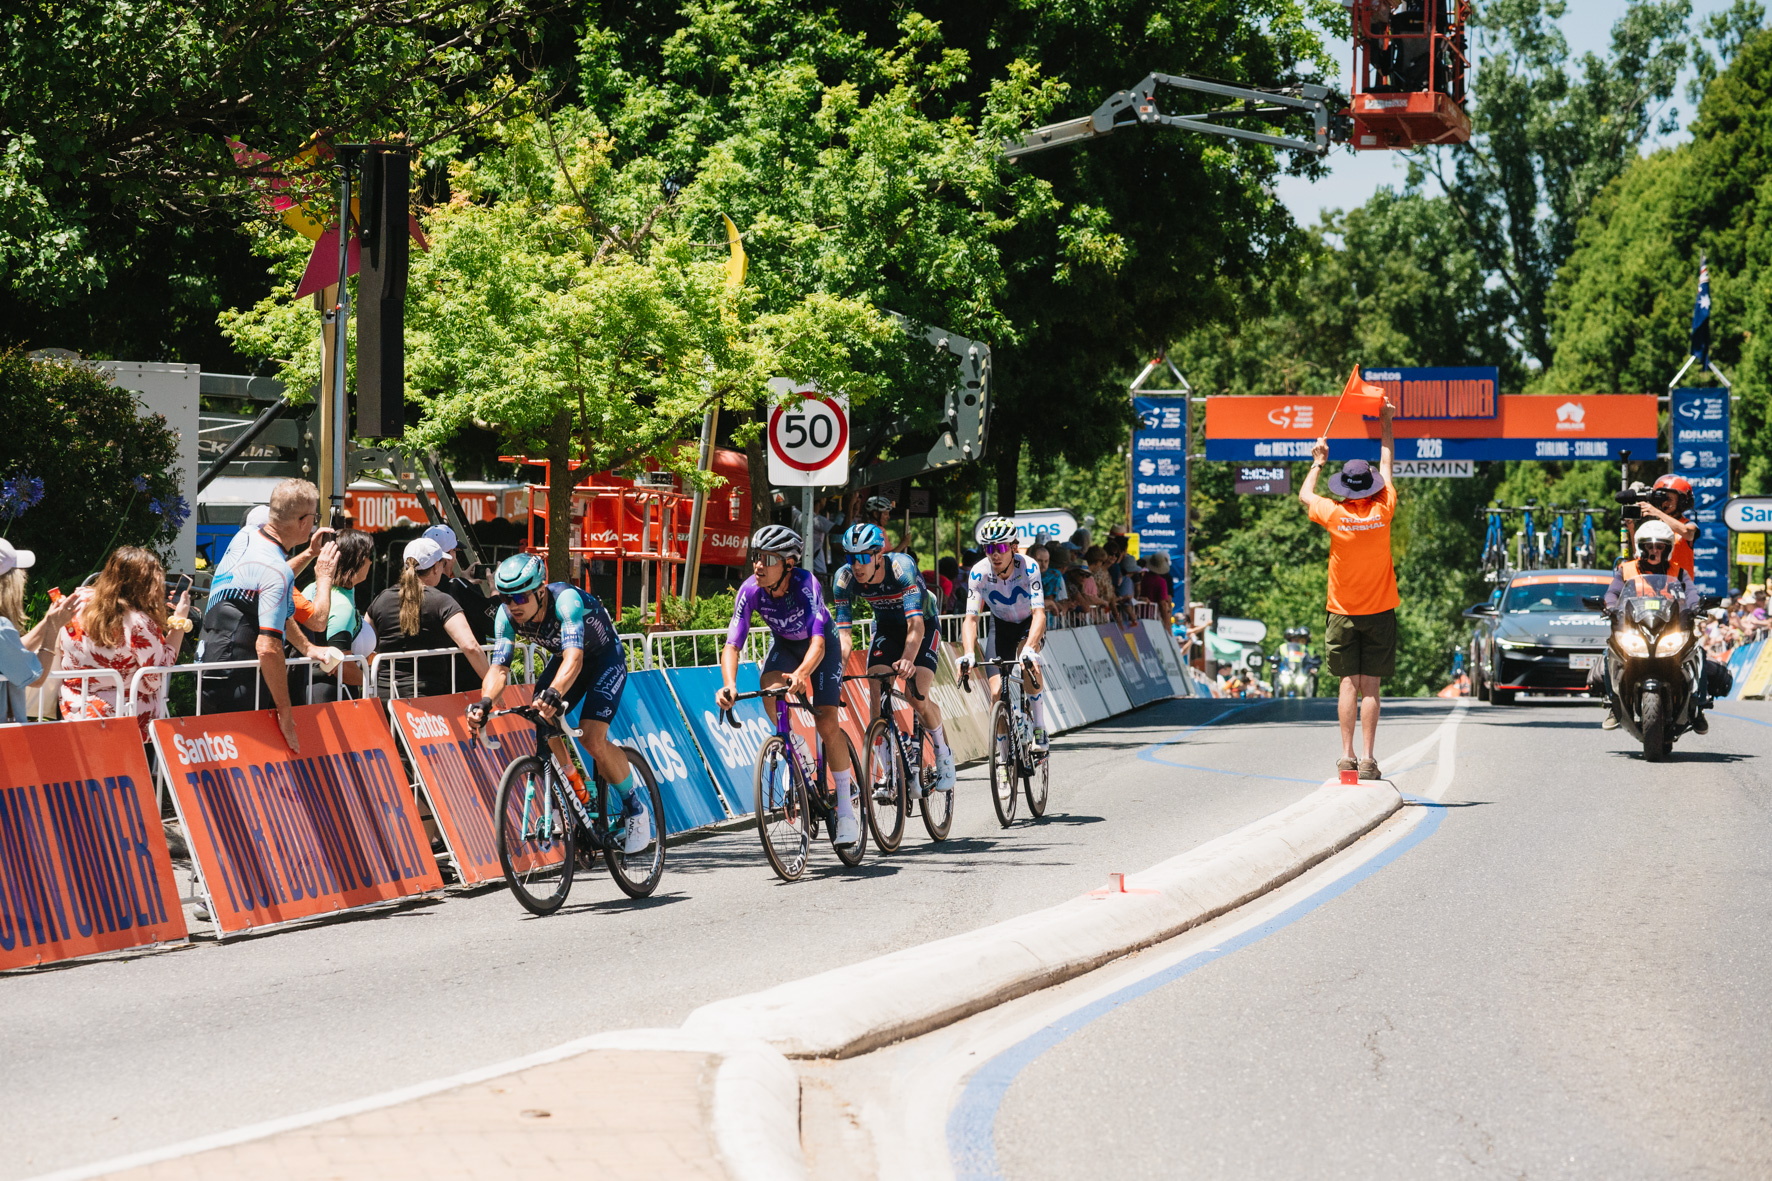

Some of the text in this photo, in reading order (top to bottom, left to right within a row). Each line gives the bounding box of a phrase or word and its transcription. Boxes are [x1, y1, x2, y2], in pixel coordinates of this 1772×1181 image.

[1365, 371, 1401, 380] Santos
[1403, 380, 1447, 417] DOWN
[1448, 379, 1494, 417] UNDER
[785, 414, 833, 449] 50
[1679, 430, 1723, 439] ADELAIDE
[1295, 442, 1316, 457] STAG
[1417, 439, 1443, 458] 2026
[1536, 441, 1569, 456] STIRLING
[1575, 441, 1608, 456] STIRLING
[1393, 462, 1468, 474] GARMIN
[1138, 483, 1180, 494] Santos
[1682, 476, 1723, 487] antos
[358, 497, 397, 527] TOUR
[397, 498, 424, 508] TH
[1147, 512, 1171, 523] efex
[1017, 522, 1061, 537] ntos
[1337, 522, 1385, 531] MARSHAL
[711, 533, 740, 547] SJ46
[407, 711, 449, 740] Santos
[173, 731, 239, 765] Santos
[420, 742, 500, 867] TOUR
[185, 748, 427, 913] TOUR DOWN UNDER
[43, 775, 168, 938] UNDER
